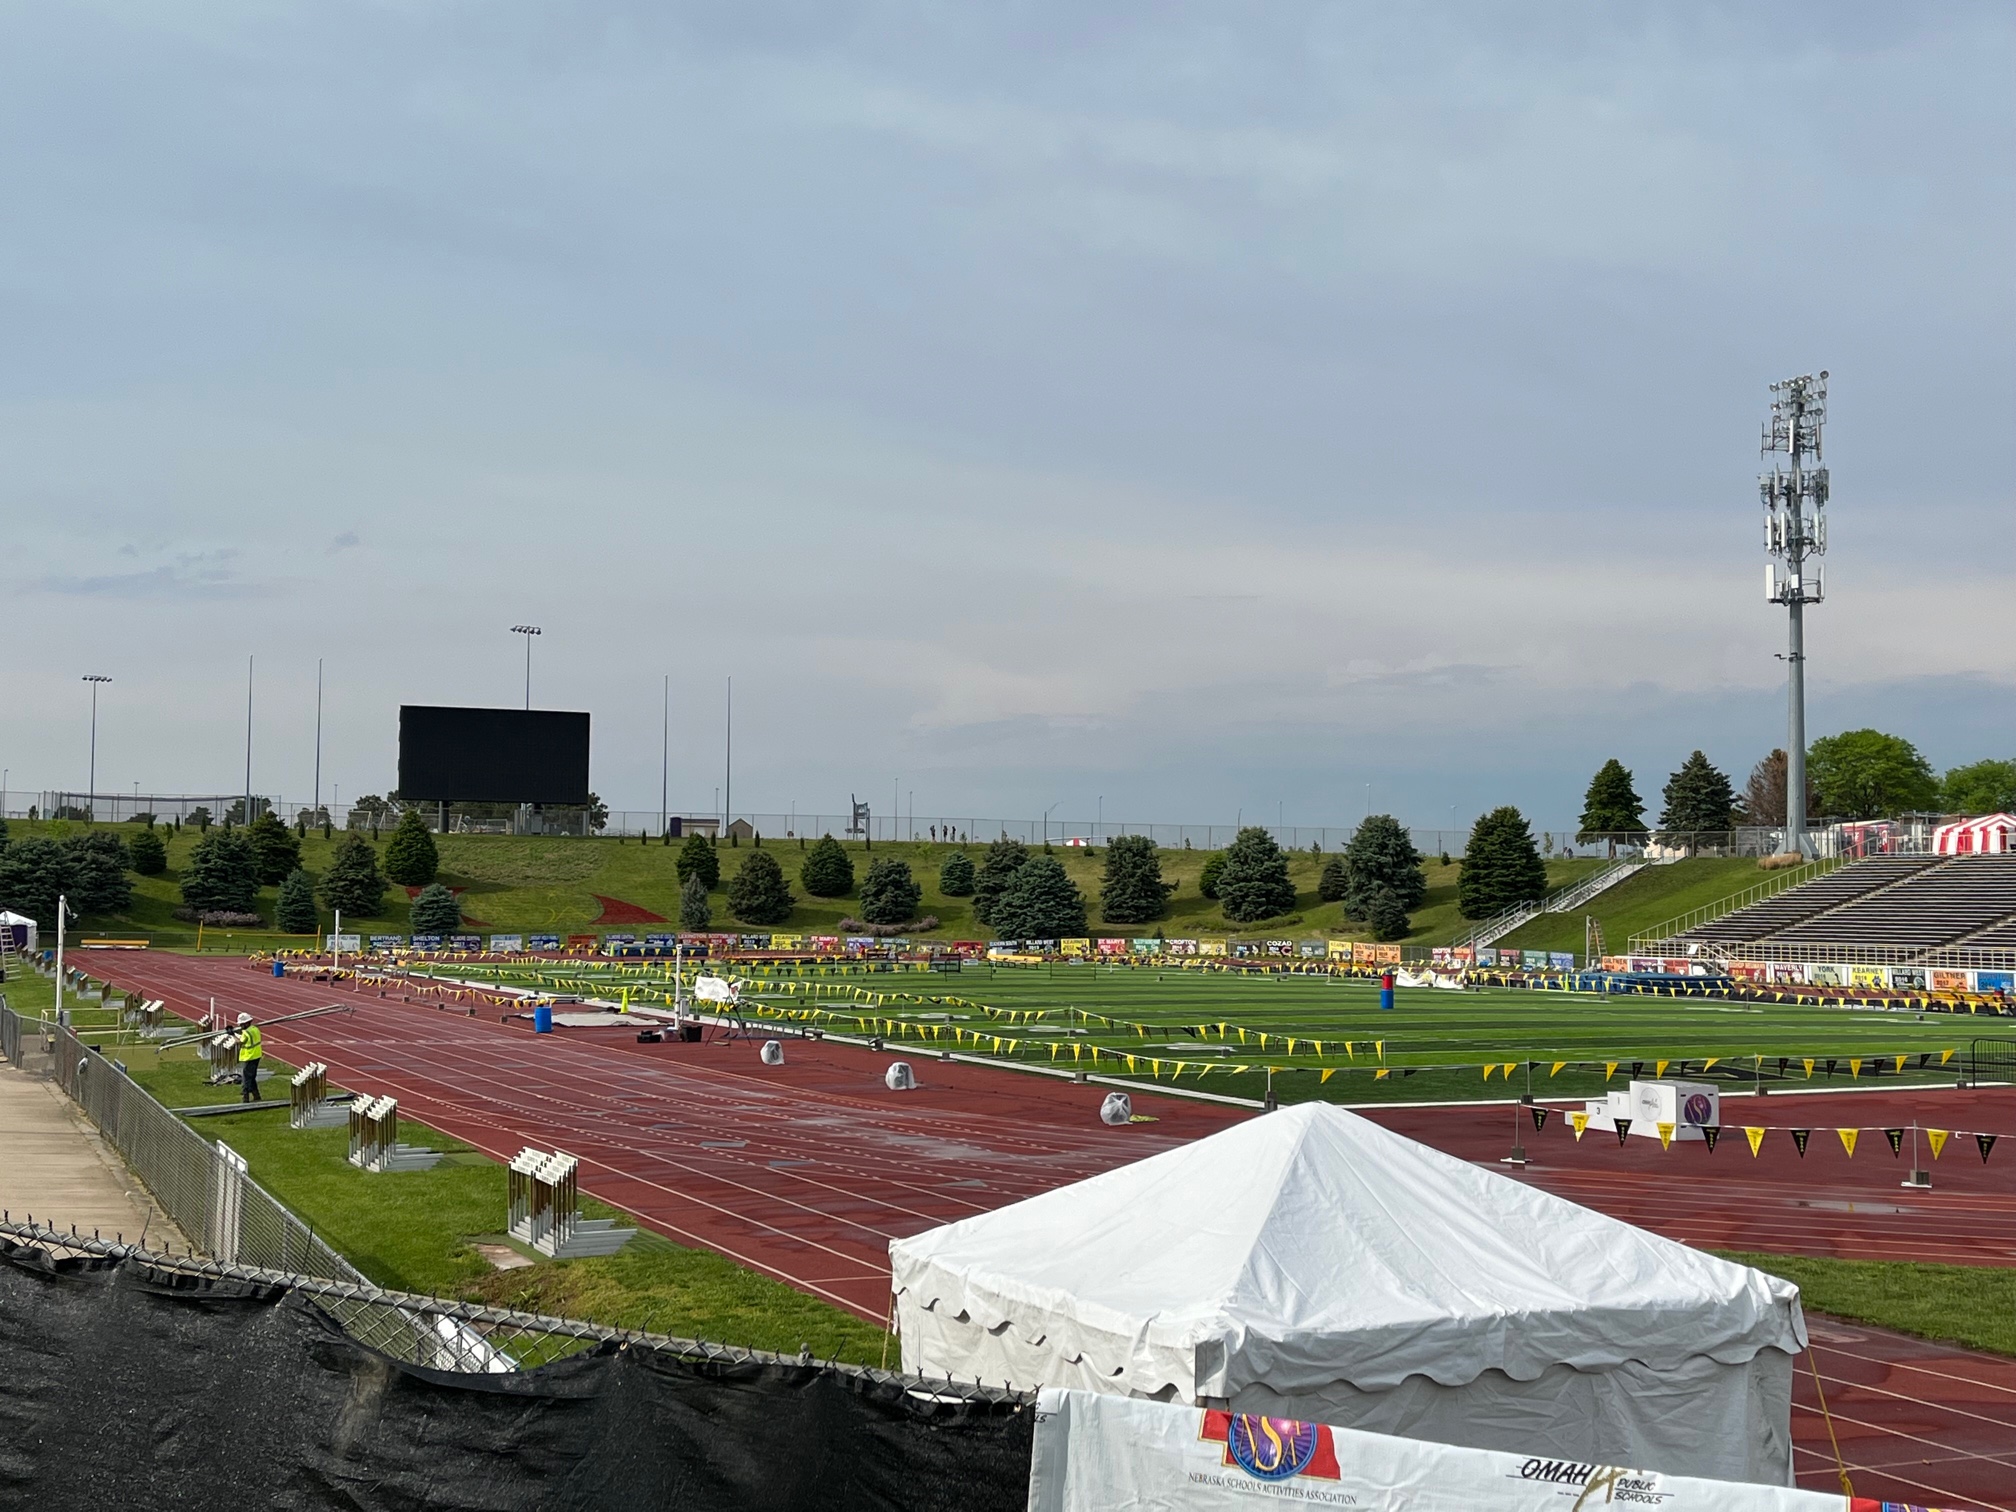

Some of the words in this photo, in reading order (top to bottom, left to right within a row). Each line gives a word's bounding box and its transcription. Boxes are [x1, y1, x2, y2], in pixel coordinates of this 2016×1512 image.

[1852, 966, 1884, 974] KEARNEY
[1933, 971, 1966, 979] GILTNER
[1597, 1106, 1601, 1115] 3
[1188, 1471, 1225, 1488] NEBRASKA
[1226, 1477, 1262, 1492] SCHOOLS
[1262, 1484, 1304, 1498] ACTIVITIES
[1305, 1489, 1357, 1505] ASSOCIATION
[1617, 1478, 1656, 1491] PUBLIC
[1614, 1491, 1664, 1505] SCHOOLS
